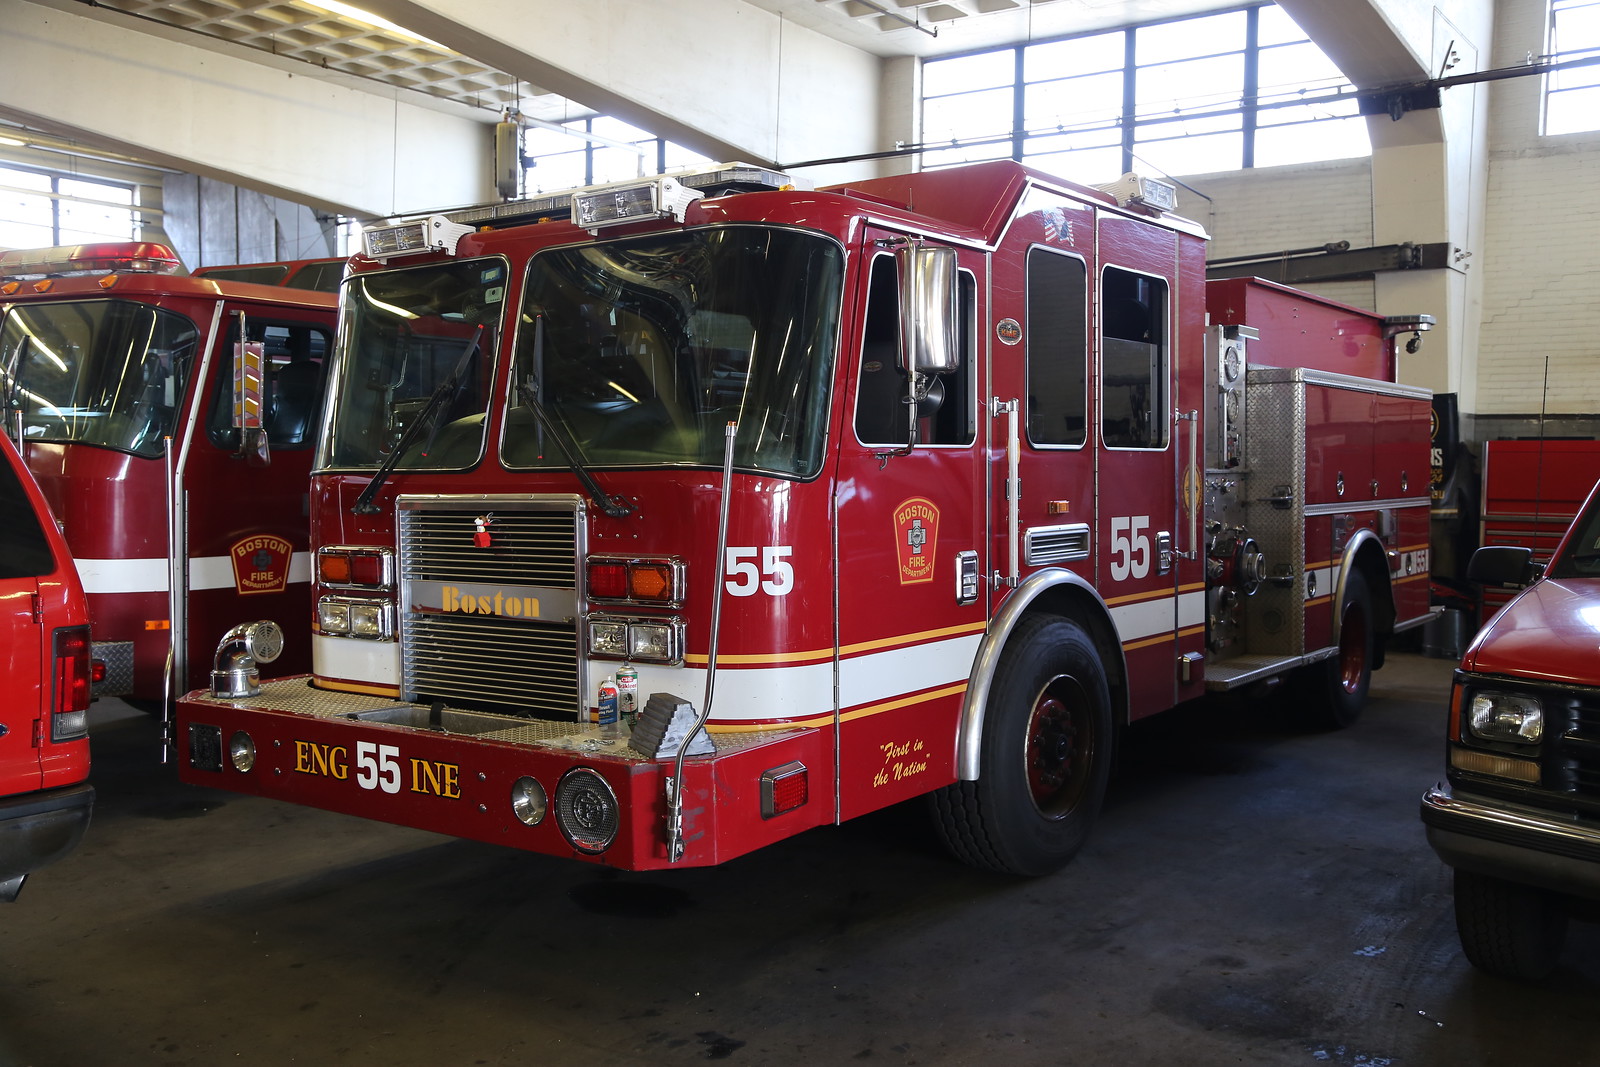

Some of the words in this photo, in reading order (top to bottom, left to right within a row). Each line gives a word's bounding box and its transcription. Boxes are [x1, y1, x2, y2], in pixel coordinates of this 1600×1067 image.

[899, 505, 935, 525] BOSTON
[236, 539, 288, 557] BOSTON
[1110, 515, 1150, 581] 55
[902, 562, 932, 577] DEPARTMENT
[909, 556, 926, 567] FIRE
[250, 571, 274, 581] FIRE
[725, 546, 794, 597] 55
[241, 576, 283, 589] DEPARTMENT
[442, 586, 540, 617] Boston
[913, 739, 924, 751] in
[294, 740, 349, 780] ENG
[356, 740, 401, 794] 55
[410, 758, 461, 799] INE
[873, 768, 889, 788] the
